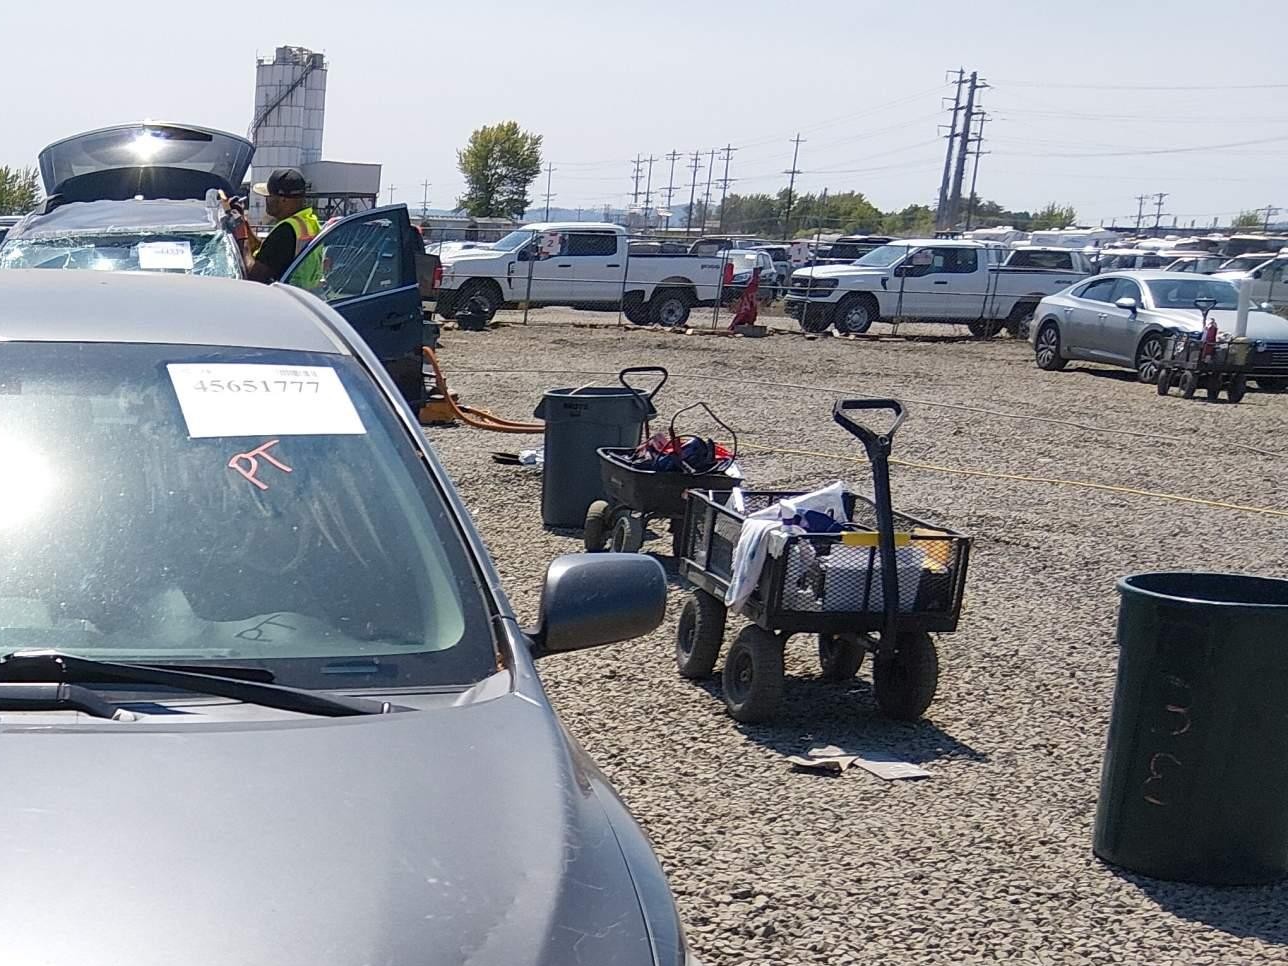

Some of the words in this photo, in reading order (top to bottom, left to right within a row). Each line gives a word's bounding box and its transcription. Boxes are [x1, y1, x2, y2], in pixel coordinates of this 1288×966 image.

[547, 239, 554, 248] 2
[193, 379, 320, 394] 45651777
[227, 439, 293, 491] PT
